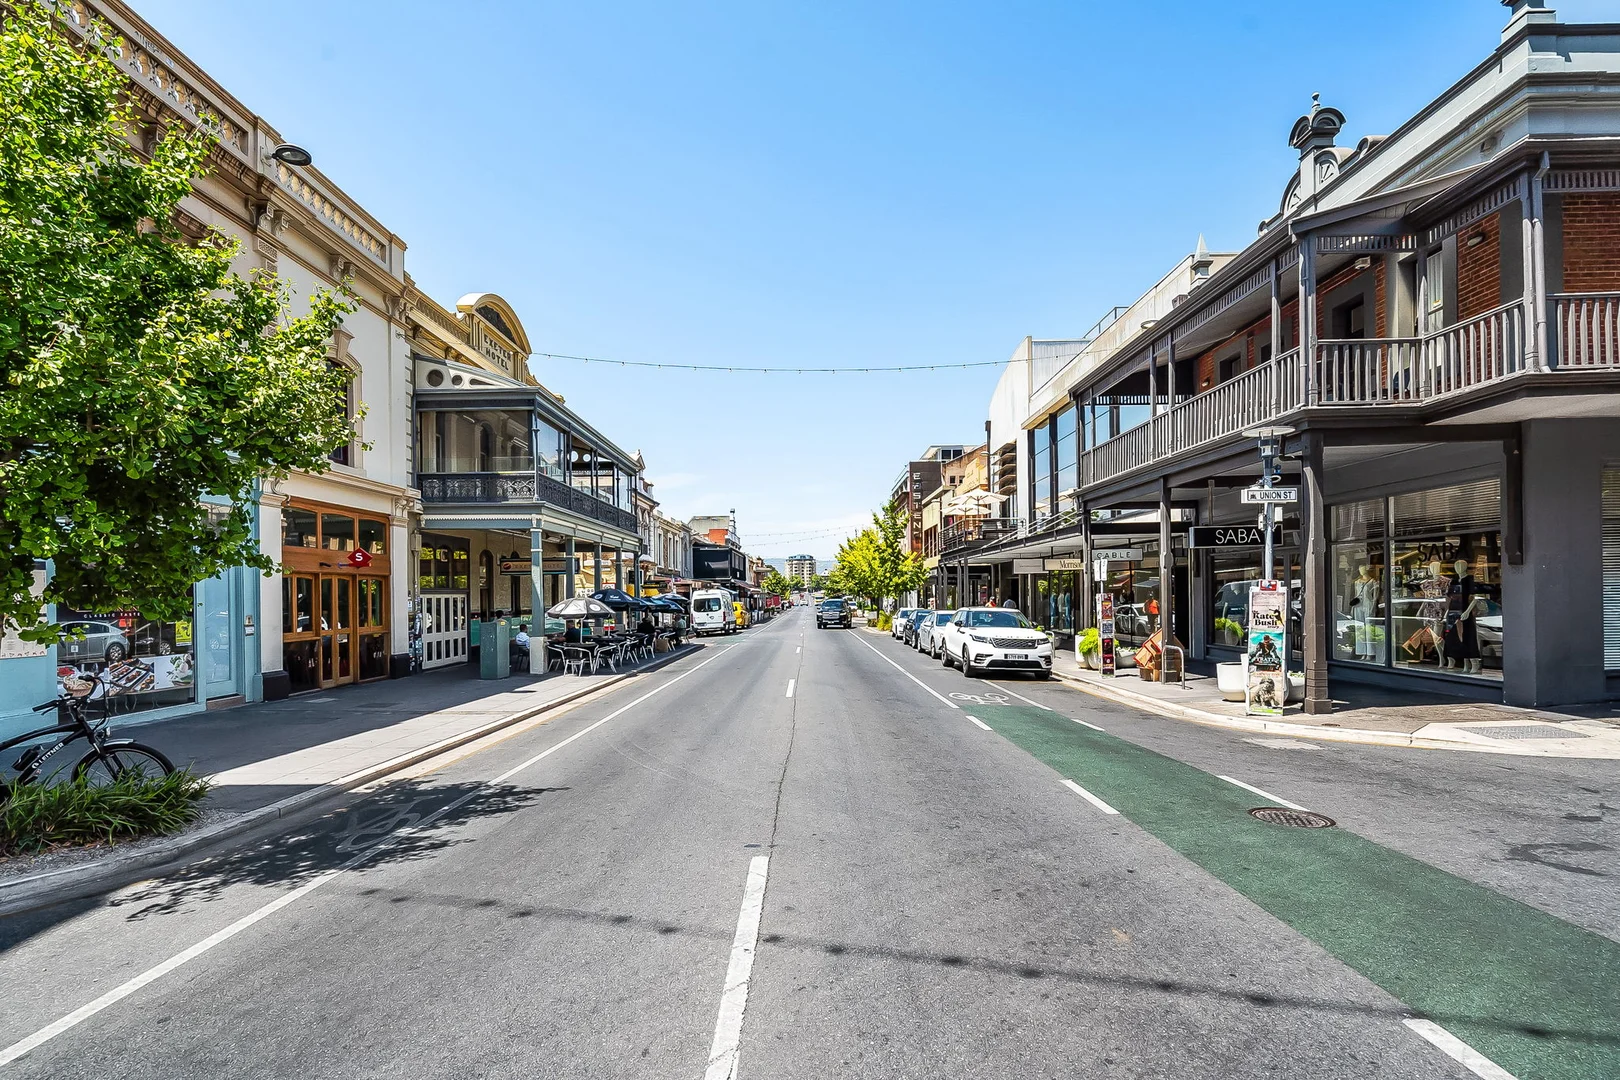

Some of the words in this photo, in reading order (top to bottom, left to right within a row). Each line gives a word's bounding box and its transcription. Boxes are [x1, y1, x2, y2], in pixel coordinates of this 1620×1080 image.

[484, 334, 511, 361] EXETER
[486, 347, 508, 370] HOTEL
[1260, 491, 1282, 500] UNION
[1283, 491, 1293, 499] ST
[1215, 529, 1261, 544] SABA
[355, 552, 364, 562] S
[1096, 551, 1131, 559] CABLE
[38, 742, 65, 764] LEITNER
